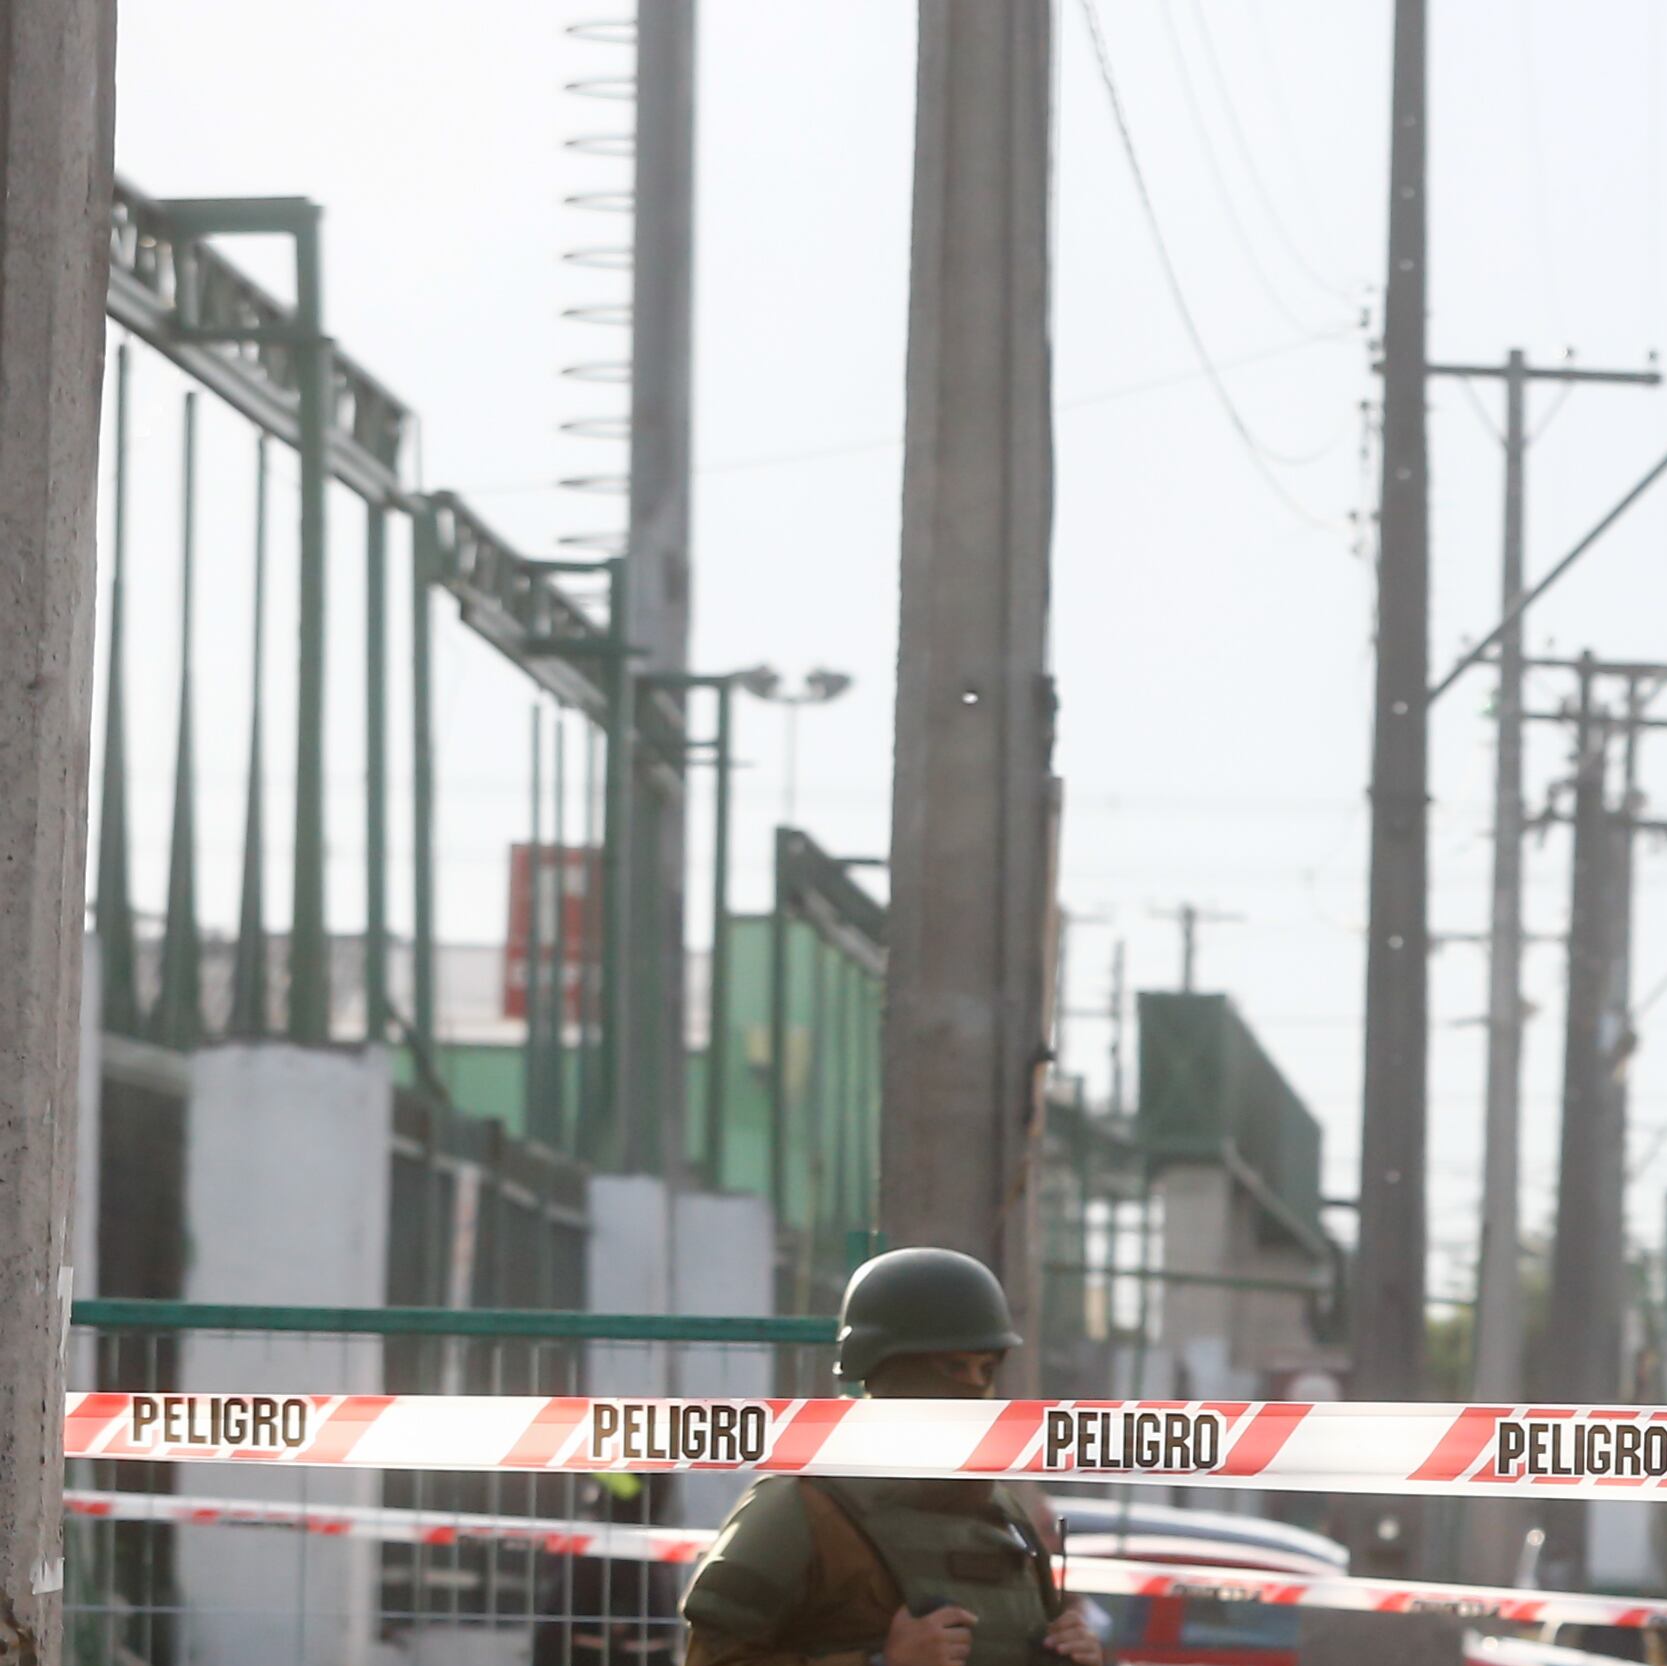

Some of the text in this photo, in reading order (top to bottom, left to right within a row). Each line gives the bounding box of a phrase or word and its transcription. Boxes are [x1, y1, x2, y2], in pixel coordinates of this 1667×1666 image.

[132, 1395, 307, 1447] PELIGRO
[592, 1403, 766, 1462] PELIGRO
[1045, 1410, 1219, 1470] PELIGRO
